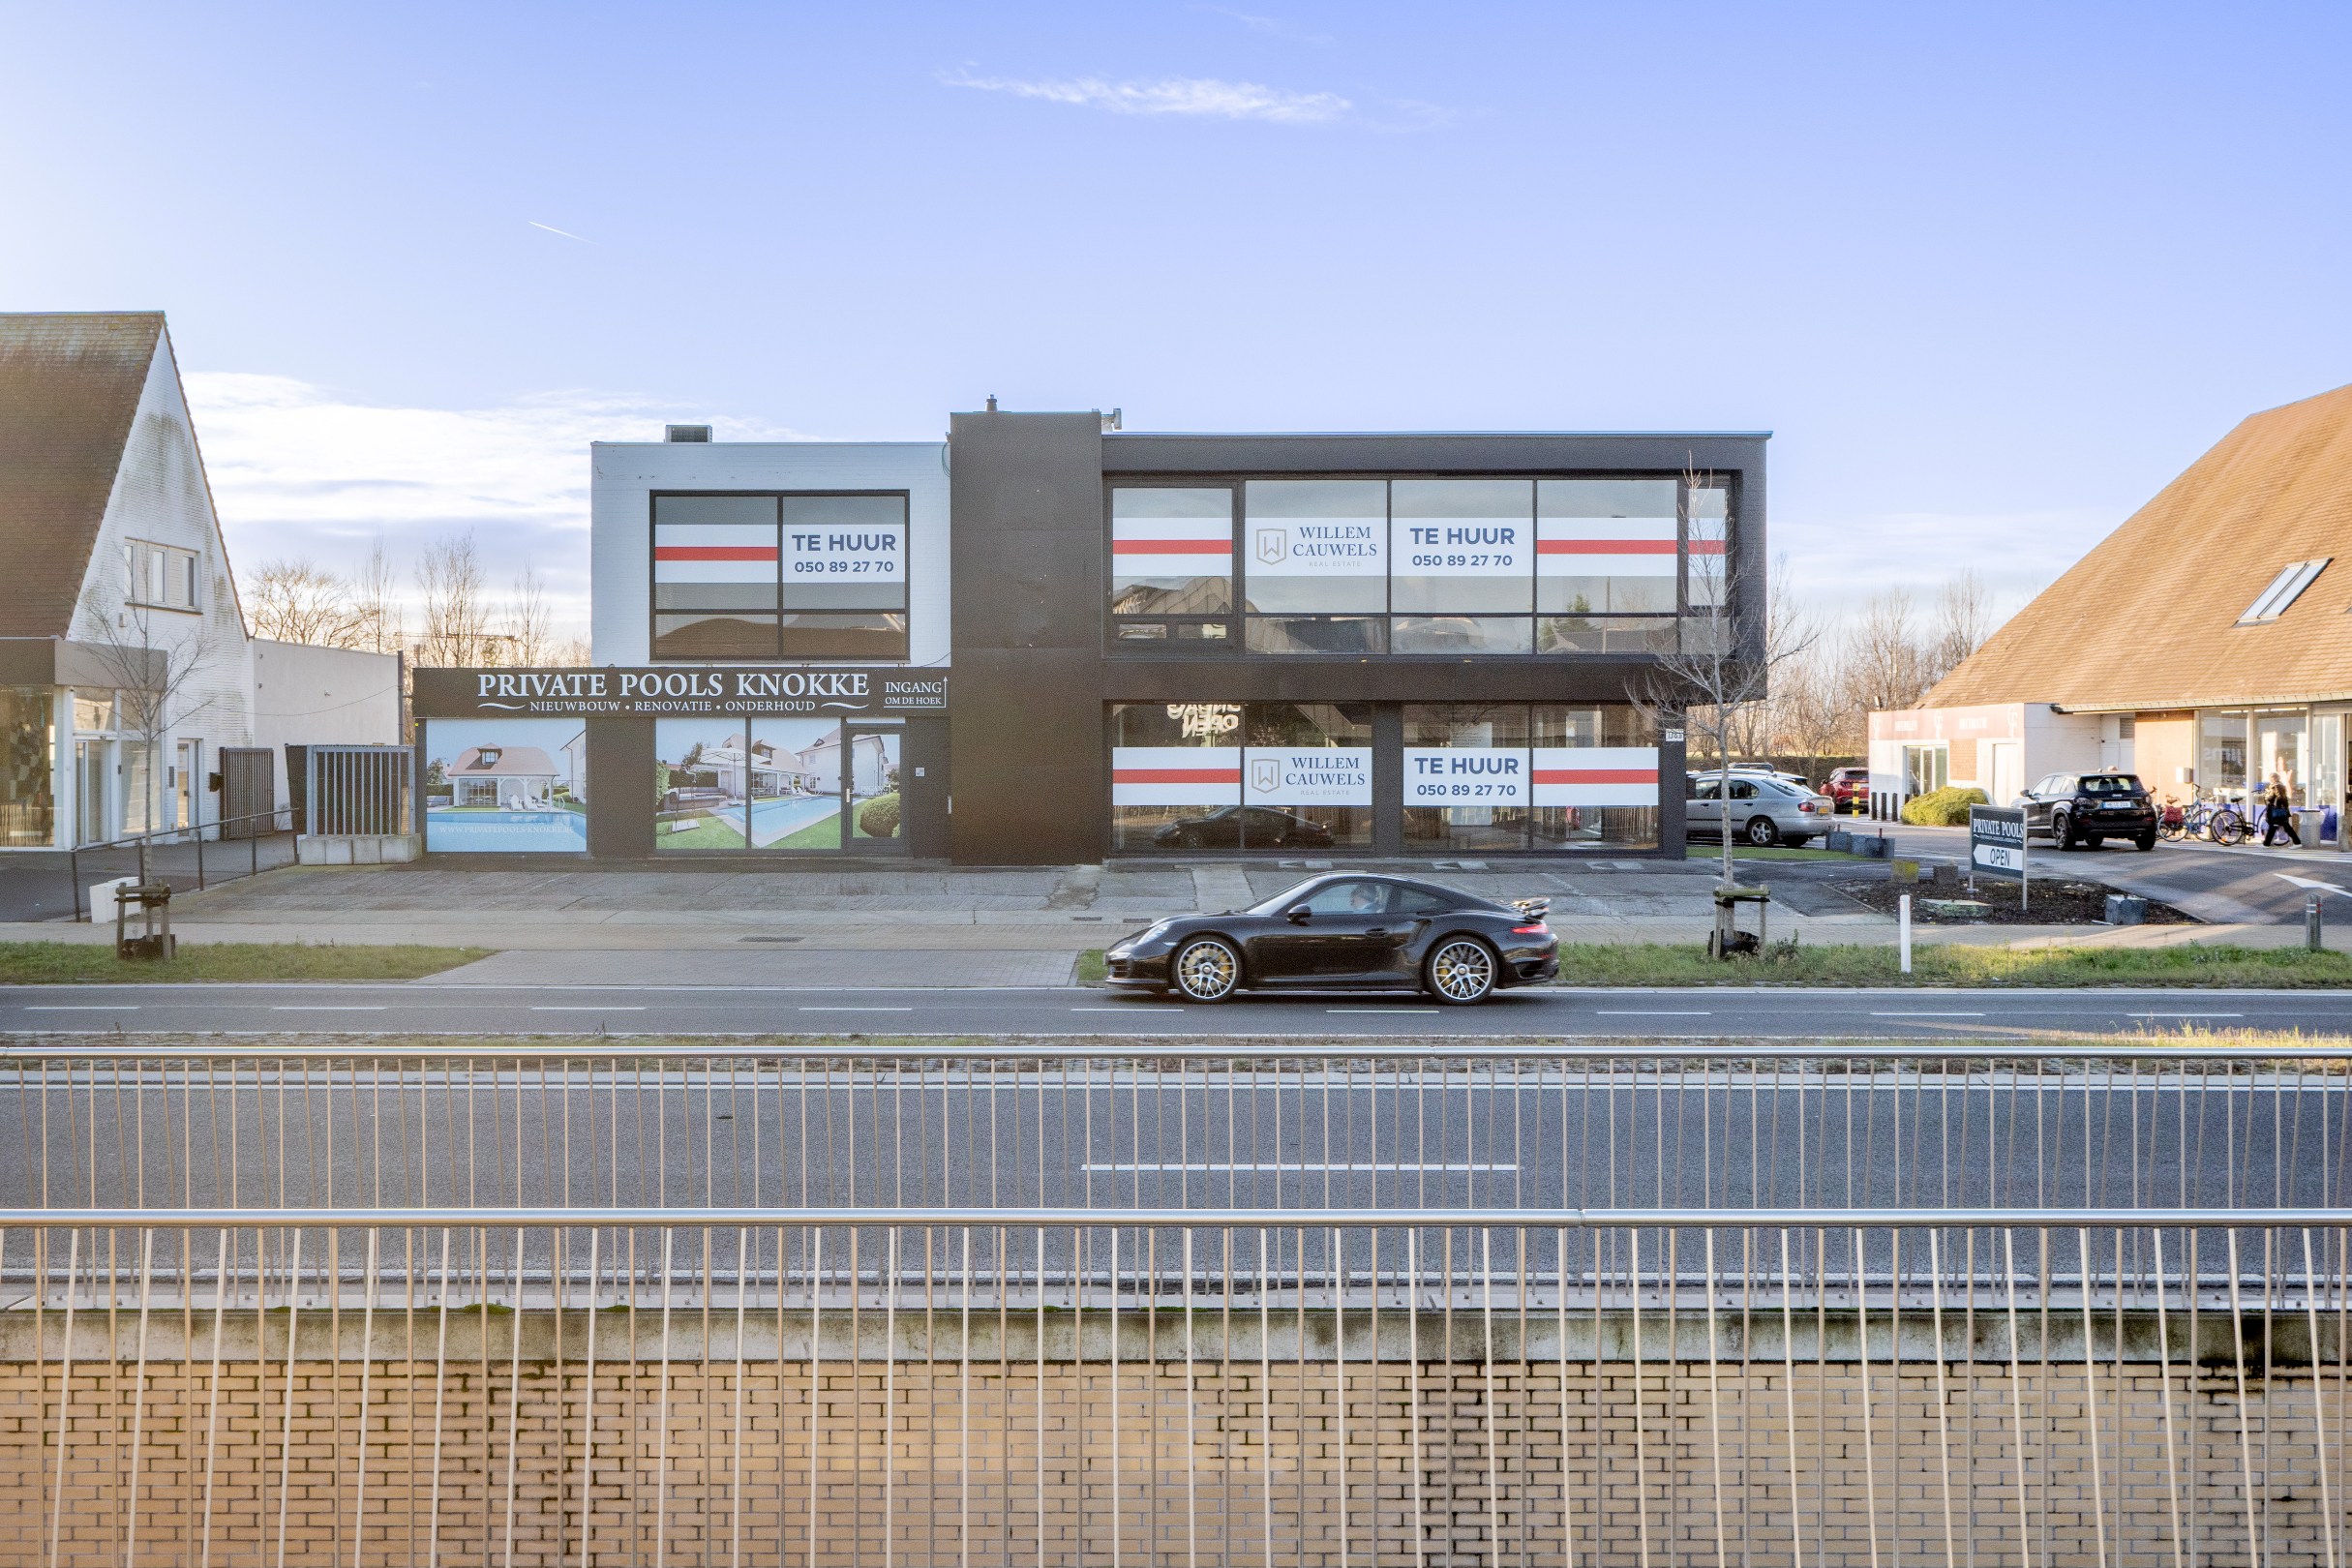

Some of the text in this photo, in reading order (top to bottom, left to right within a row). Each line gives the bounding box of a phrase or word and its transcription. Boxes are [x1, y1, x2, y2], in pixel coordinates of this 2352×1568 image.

[1299, 526, 1372, 539] WILLEM
[1409, 528, 1516, 545] TE HUUR
[791, 533, 896, 552] TE HUUR
[1292, 543, 1377, 557] CAUWELS
[794, 560, 894, 573] 050 89 27 70
[1411, 555, 1513, 567] 050 89 27 70
[477, 673, 870, 697] PRIVATE POOLS KNOKKE
[885, 681, 942, 694] INGANG
[529, 701, 816, 711] NIEUWBOUW RENOVATIE ONDERHOUD
[885, 696, 901, 705] OM
[1290, 757, 1360, 769] WILLEM
[1413, 757, 1519, 775] TE HUUR
[1284, 772, 1366, 786] CAUWELS
[1416, 784, 1517, 797] 050 89 27 70
[1973, 818, 2001, 835] PRIVATE
[2001, 821, 2024, 839] POOLS
[1989, 848, 2010, 867] OPEN
